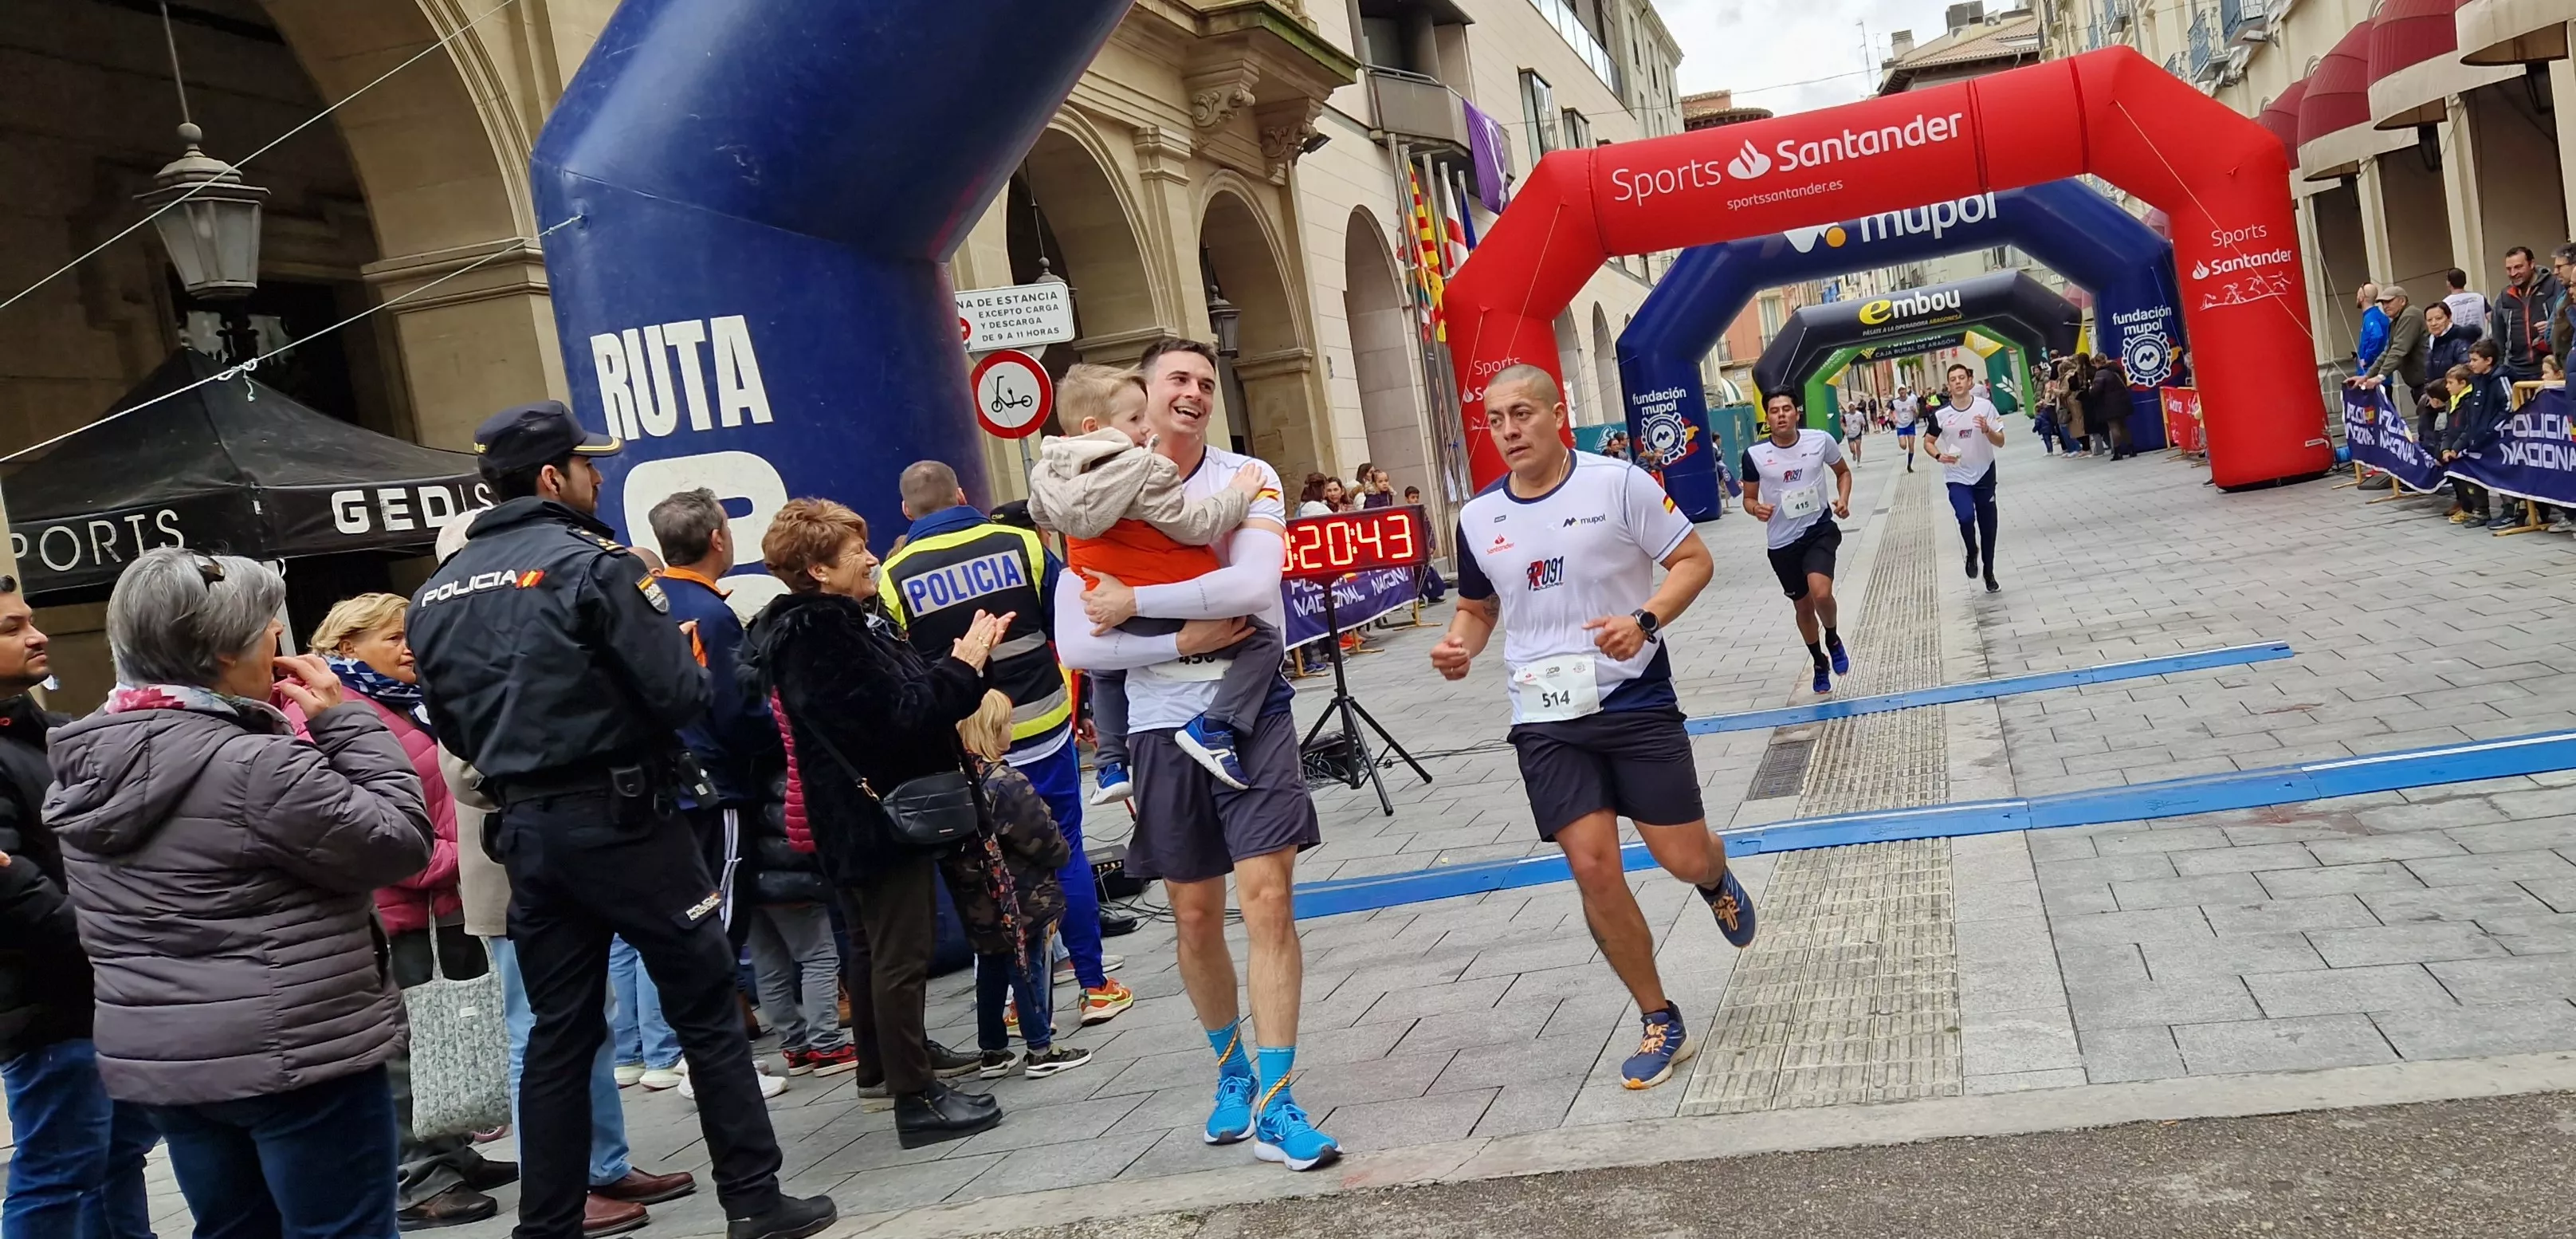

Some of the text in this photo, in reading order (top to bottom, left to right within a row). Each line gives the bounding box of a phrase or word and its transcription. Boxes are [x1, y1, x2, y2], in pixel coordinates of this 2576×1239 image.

[1612, 112, 1962, 206] Sports Santander
[1726, 179, 1844, 211] sportssantander.es
[1860, 191, 1997, 242] mupol
[2211, 224, 2268, 248] Sports
[2211, 248, 2292, 275] Santander
[977, 297, 992, 307] DE
[996, 291, 1058, 305] ESTANCIA
[1859, 289, 1961, 325] embou
[979, 304, 1059, 318] EXCEPTO CARGA
[2112, 305, 2172, 325] fundación
[989, 317, 1043, 328] DESCARGA
[1027, 327, 1060, 337] HORAS
[2124, 318, 2163, 335] mupol
[590, 315, 774, 441] RUTA
[1632, 387, 1687, 406] fundación
[1642, 399, 1677, 415] mupol
[1795, 502, 1809, 510] 415
[1581, 513, 1606, 525] mupol
[421, 568, 518, 608] POLICIA
[907, 555, 1022, 612] POLICIA
[1293, 585, 1365, 618] NACNAL
[1541, 690, 1571, 708] 514
